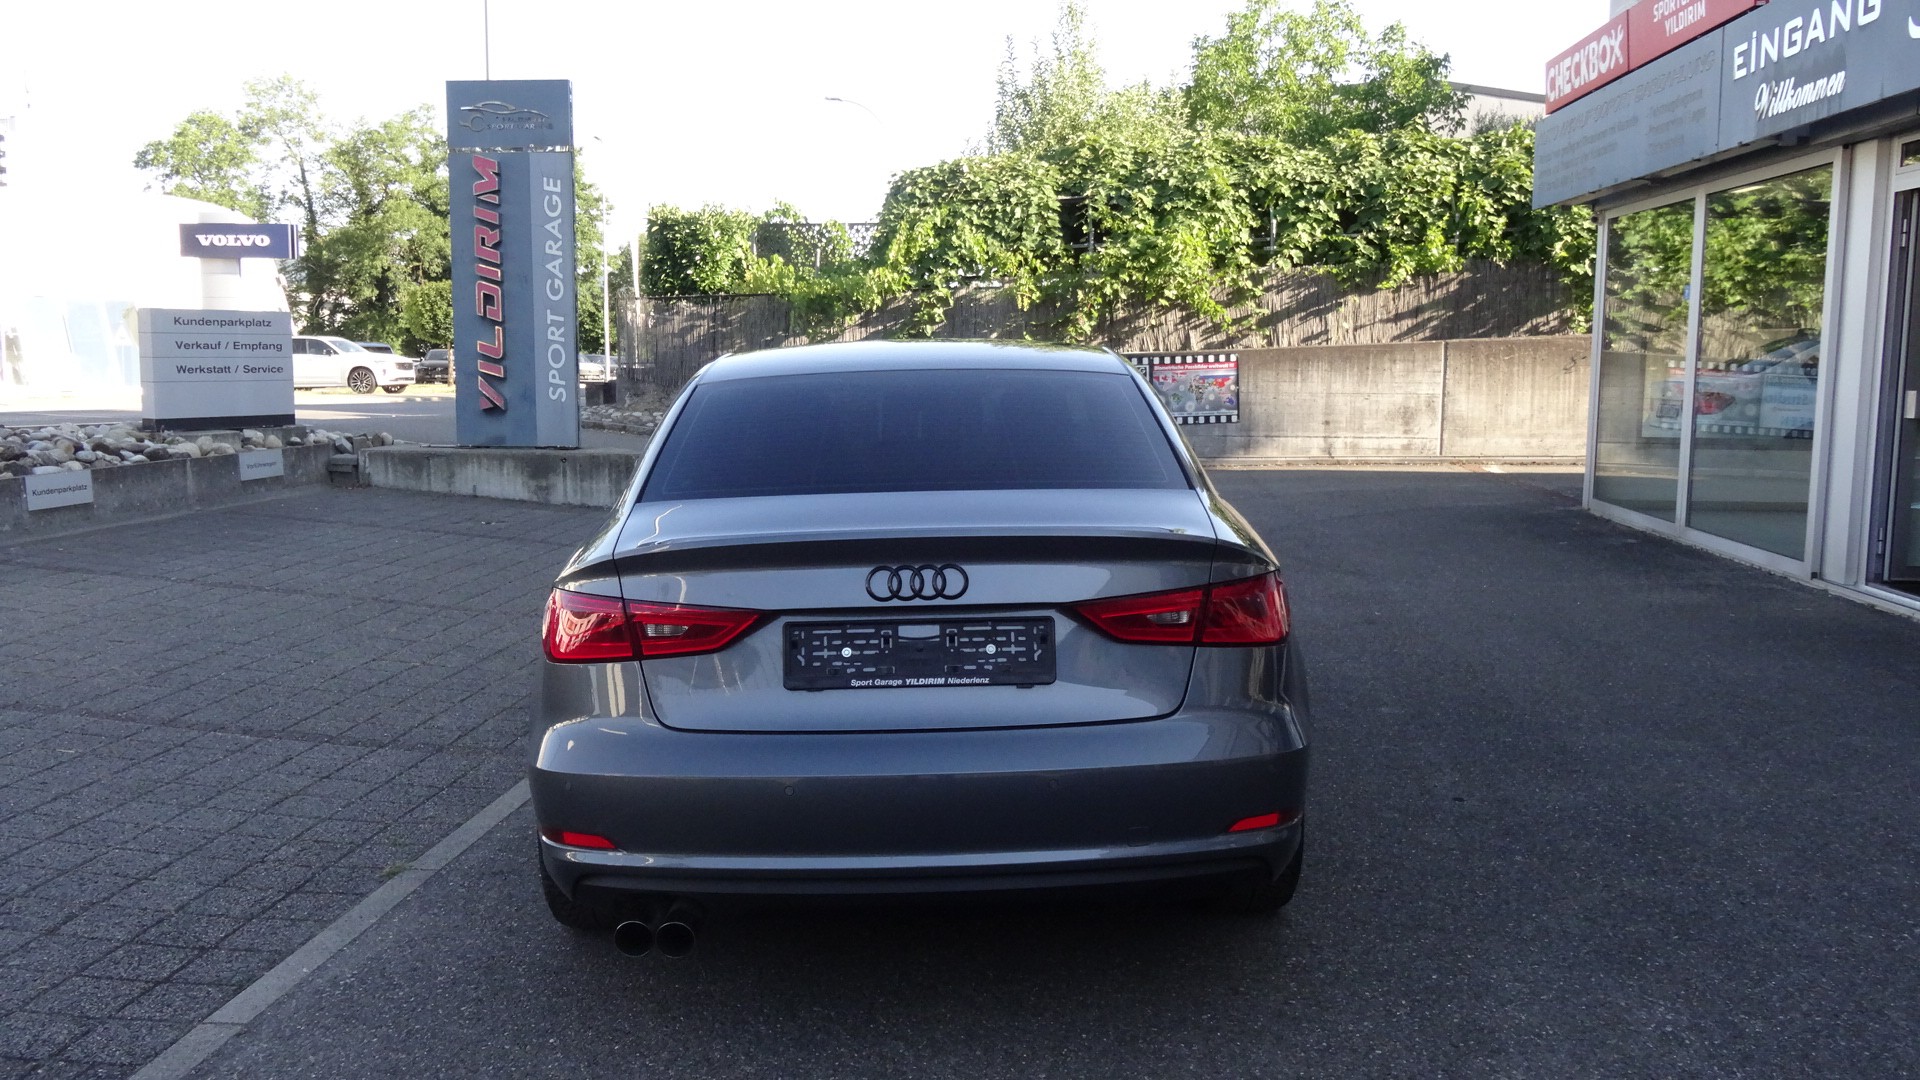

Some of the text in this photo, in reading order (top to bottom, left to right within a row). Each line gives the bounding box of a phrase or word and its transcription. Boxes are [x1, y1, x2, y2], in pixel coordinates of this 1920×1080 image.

[1664, 0, 1706, 37] YILDIRIM
[1546, 24, 1624, 102] CHECKBOX
[1754, 70, 1846, 121] Willkommen
[195, 234, 271, 247] VOLVO
[472, 154, 504, 411] YILDIRIM
[543, 177, 566, 402] SPORT GARAGE
[173, 316, 272, 329] Kundenparkplatz
[175, 340, 222, 350] Verkauf
[233, 341, 283, 352] Empfang
[176, 364, 231, 374] Werkstatt
[243, 364, 284, 374] Service
[31, 484, 88, 497] Kundenparkplatz
[850, 679, 873, 687] Sport
[874, 678, 903, 687] Garage
[905, 677, 945, 685] YILDIRIM
